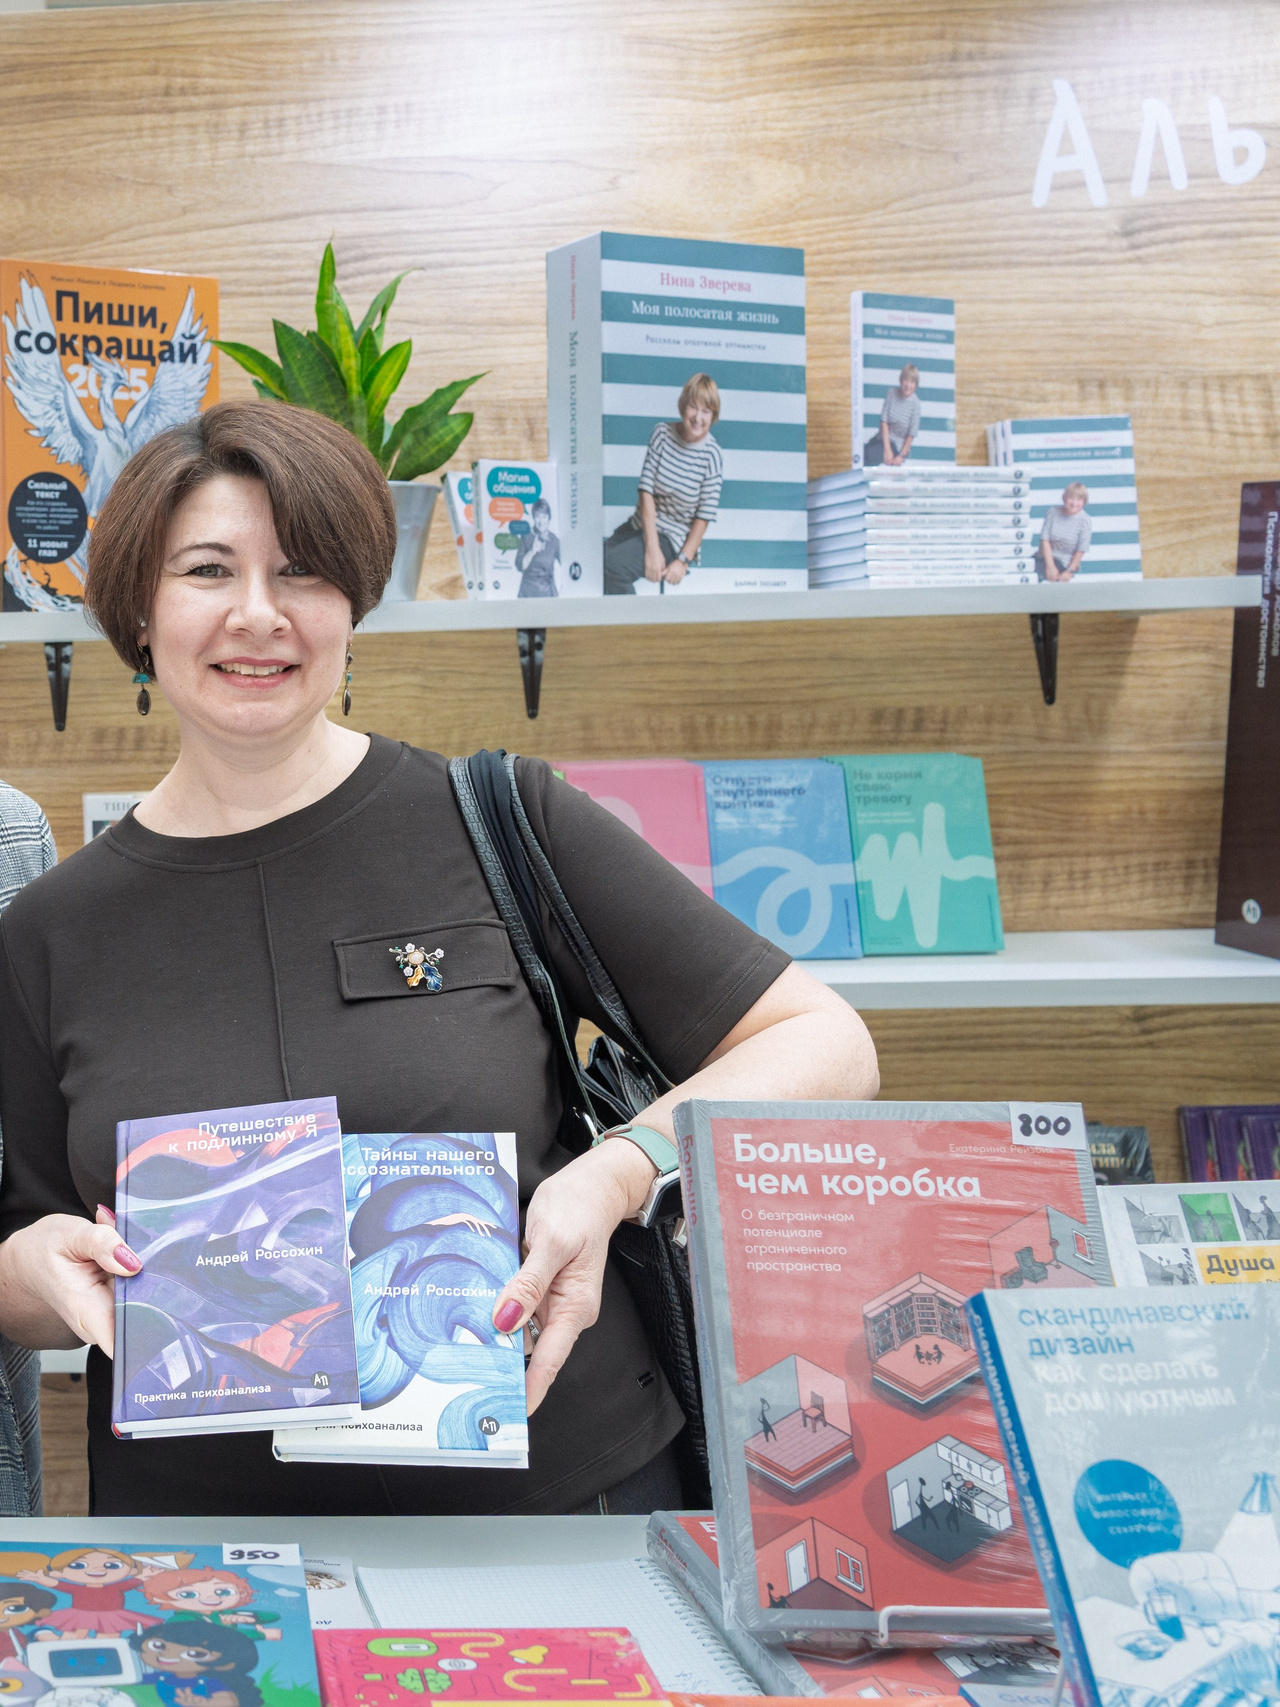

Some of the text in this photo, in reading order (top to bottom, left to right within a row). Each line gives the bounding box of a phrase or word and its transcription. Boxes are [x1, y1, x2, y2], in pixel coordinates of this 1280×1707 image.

[660, 272, 752, 295] Нина Зверева
[56, 290, 168, 334] Пиши,
[631, 300, 780, 325] Моя полосатая жизнь
[15, 330, 198, 367] сокращай
[27, 480, 67, 491] Сильный
[498, 471, 530, 483] Магия
[35, 491, 60, 499] текст
[492, 483, 536, 496] общения
[27, 539, 68, 549] 11 новых
[38, 550, 58, 558] глав
[1263, 511, 1278, 594] Психология
[1256, 598, 1271, 688] достоинства
[198, 1113, 316, 1136] Путешествие
[1018, 1113, 1071, 1137] 800
[168, 1124, 317, 1154] к подлинному Я
[949, 1143, 1007, 1155] Екатерина
[361, 1147, 495, 1161] Тайны нашего
[733, 1133, 887, 1170] Больше,
[735, 1168, 981, 1205] чем коробка
[741, 1208, 855, 1224] О безграничном
[743, 1227, 823, 1241] потенциале
[195, 1246, 323, 1267] Андрей Россохин
[745, 1243, 847, 1259] ограниченного
[746, 1260, 842, 1276] пространства
[1206, 1253, 1275, 1277] Душа
[364, 1283, 496, 1297] Андрей Россохин
[1018, 1297, 1250, 1328] скандинавский
[1028, 1324, 1135, 1360] дизайн
[1035, 1358, 1219, 1385] как сделать
[134, 1384, 272, 1405] Практика психоанализа
[1044, 1387, 1237, 1418] дом уютным
[229, 1549, 281, 1561] 950
